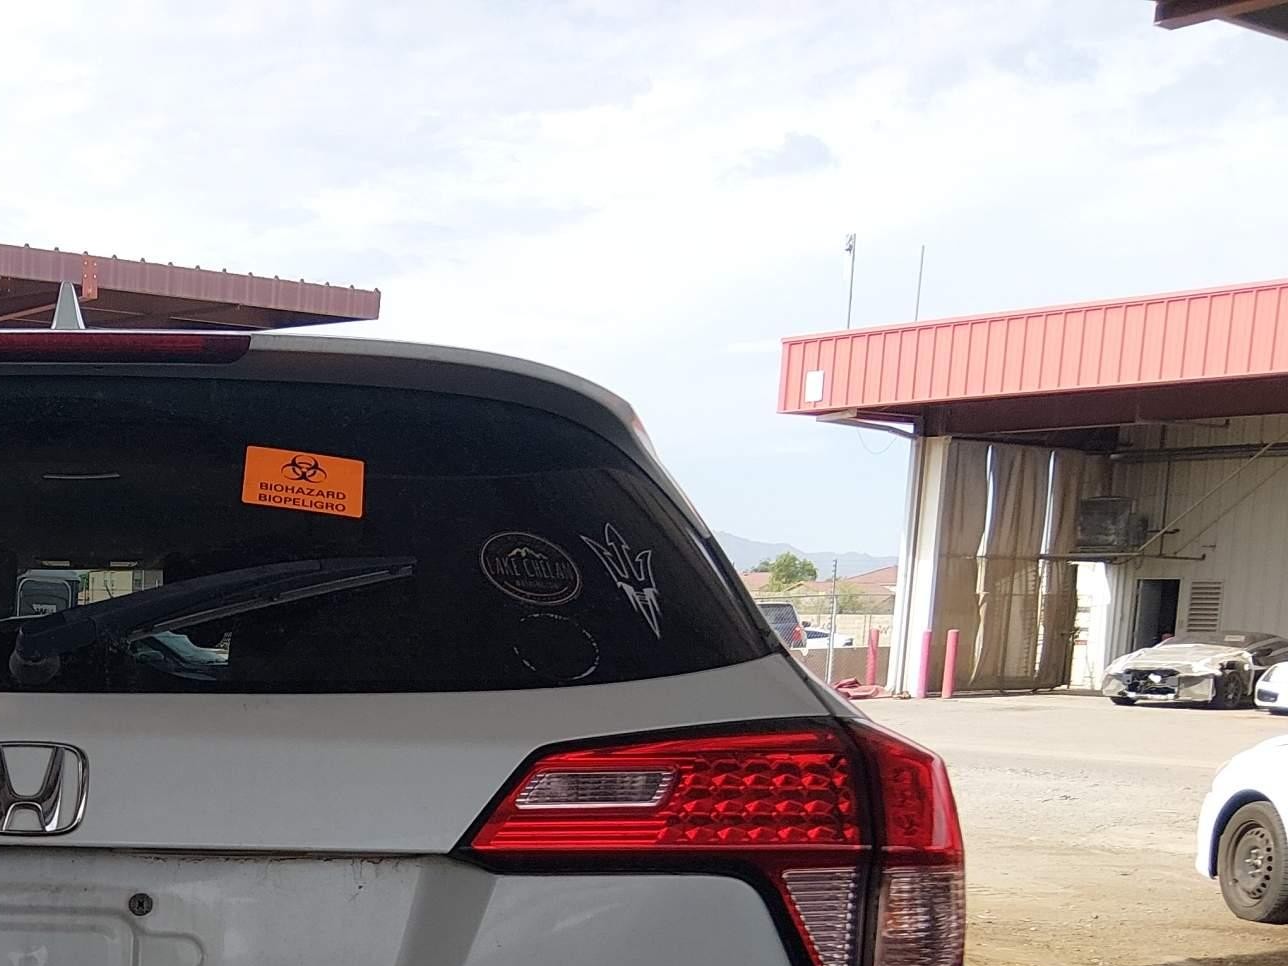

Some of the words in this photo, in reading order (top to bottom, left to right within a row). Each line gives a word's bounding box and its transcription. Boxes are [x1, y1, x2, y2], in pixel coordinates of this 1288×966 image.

[259, 482, 346, 500] BIOHAZARD
[258, 493, 346, 512] BIOPELIGRO
[486, 556, 521, 576] LAKE
